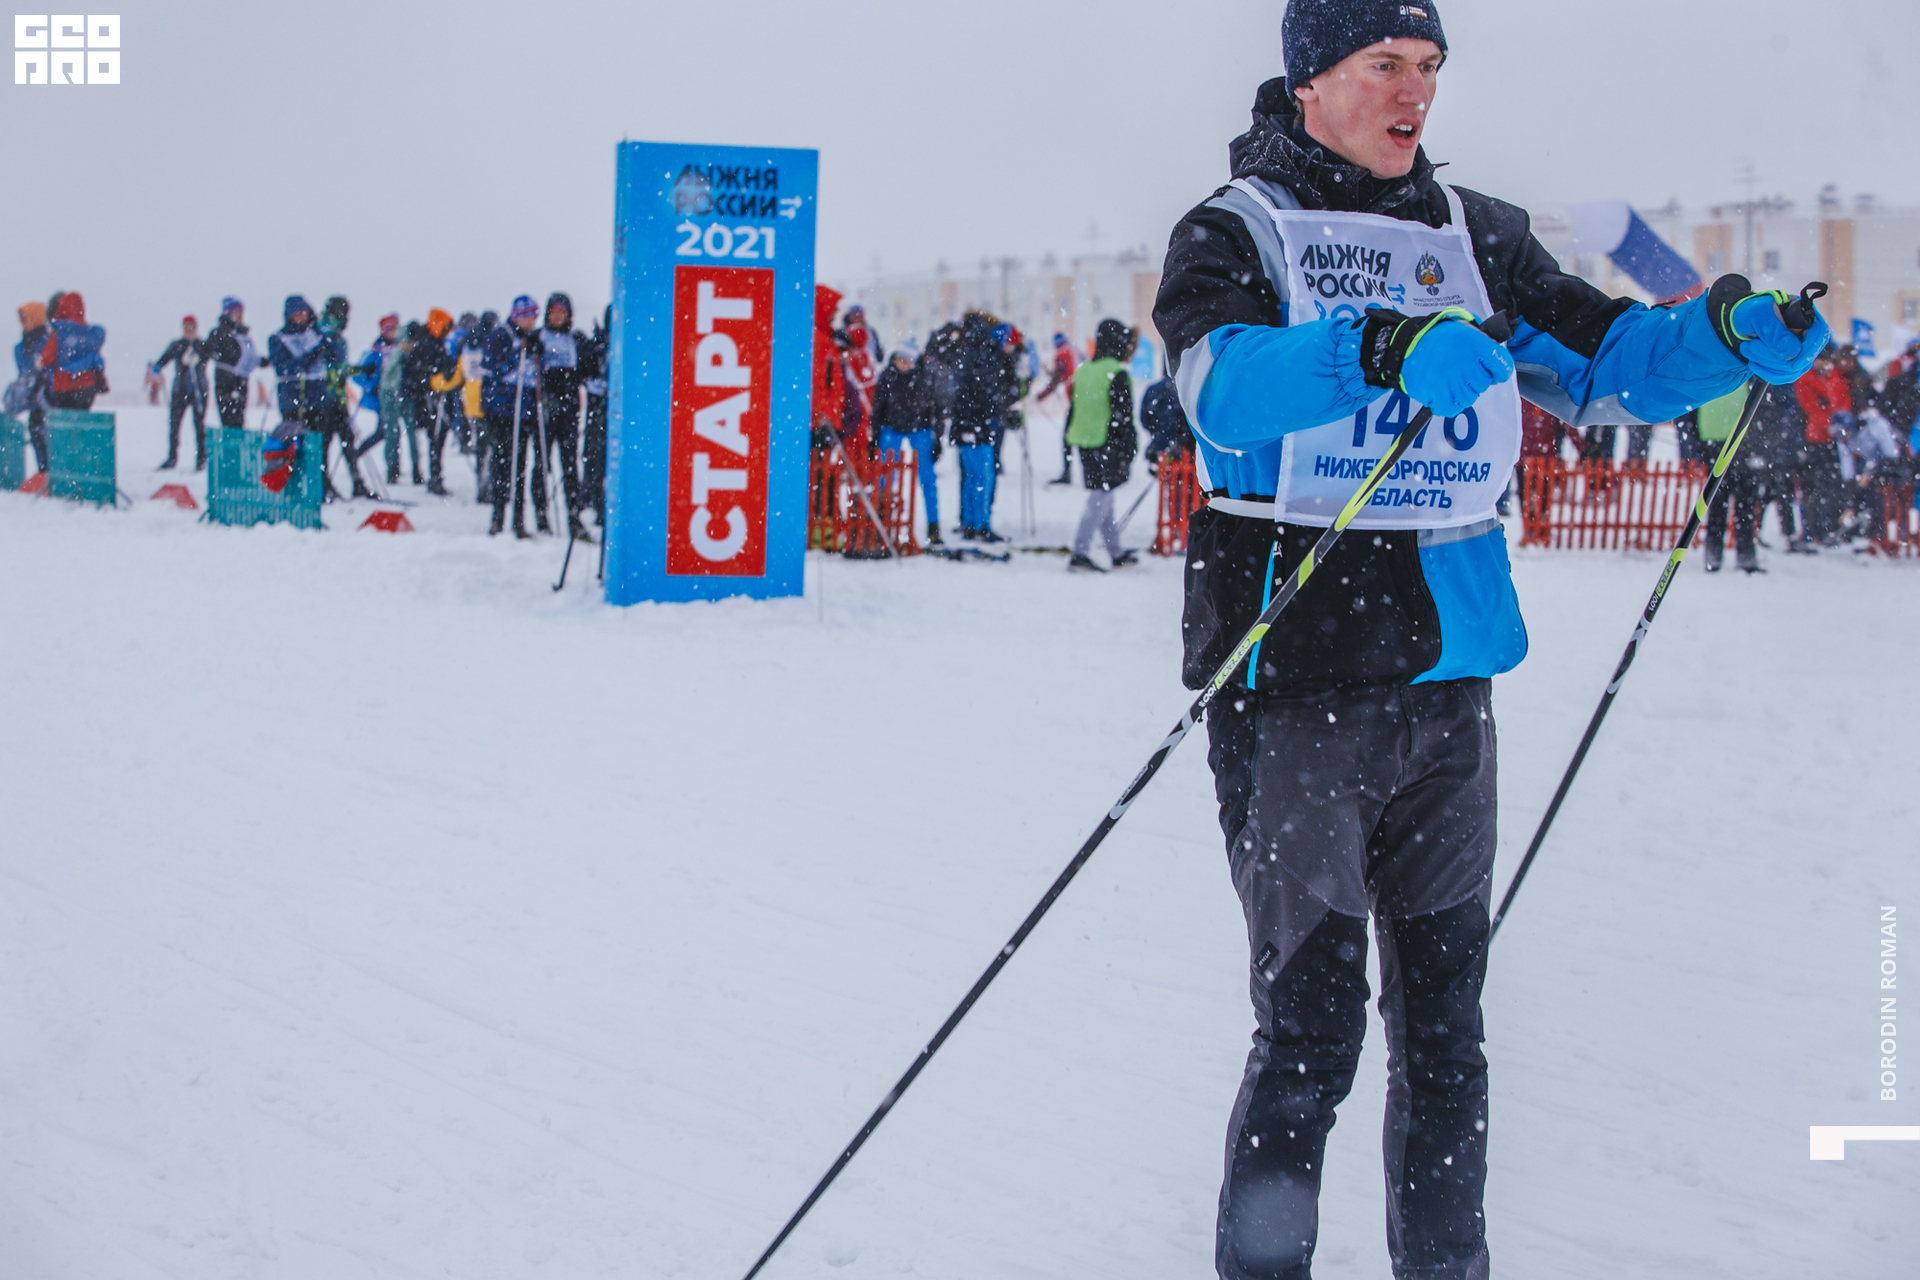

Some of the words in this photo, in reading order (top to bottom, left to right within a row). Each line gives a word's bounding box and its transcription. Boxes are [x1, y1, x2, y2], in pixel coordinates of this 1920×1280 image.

[674, 163, 778, 190] ЛЫЖНЯ
[675, 191, 777, 218] РОССИИ
[675, 223, 775, 259] 2021
[1300, 244, 1391, 277] ЛЫЖНЯ
[1303, 271, 1392, 302] РОССИИ
[689, 281, 753, 561] СТАРТ
[1314, 455, 1491, 484] НИЖЕОРОДСКАЯ
[1364, 488, 1452, 508] БЛАСТЬ
